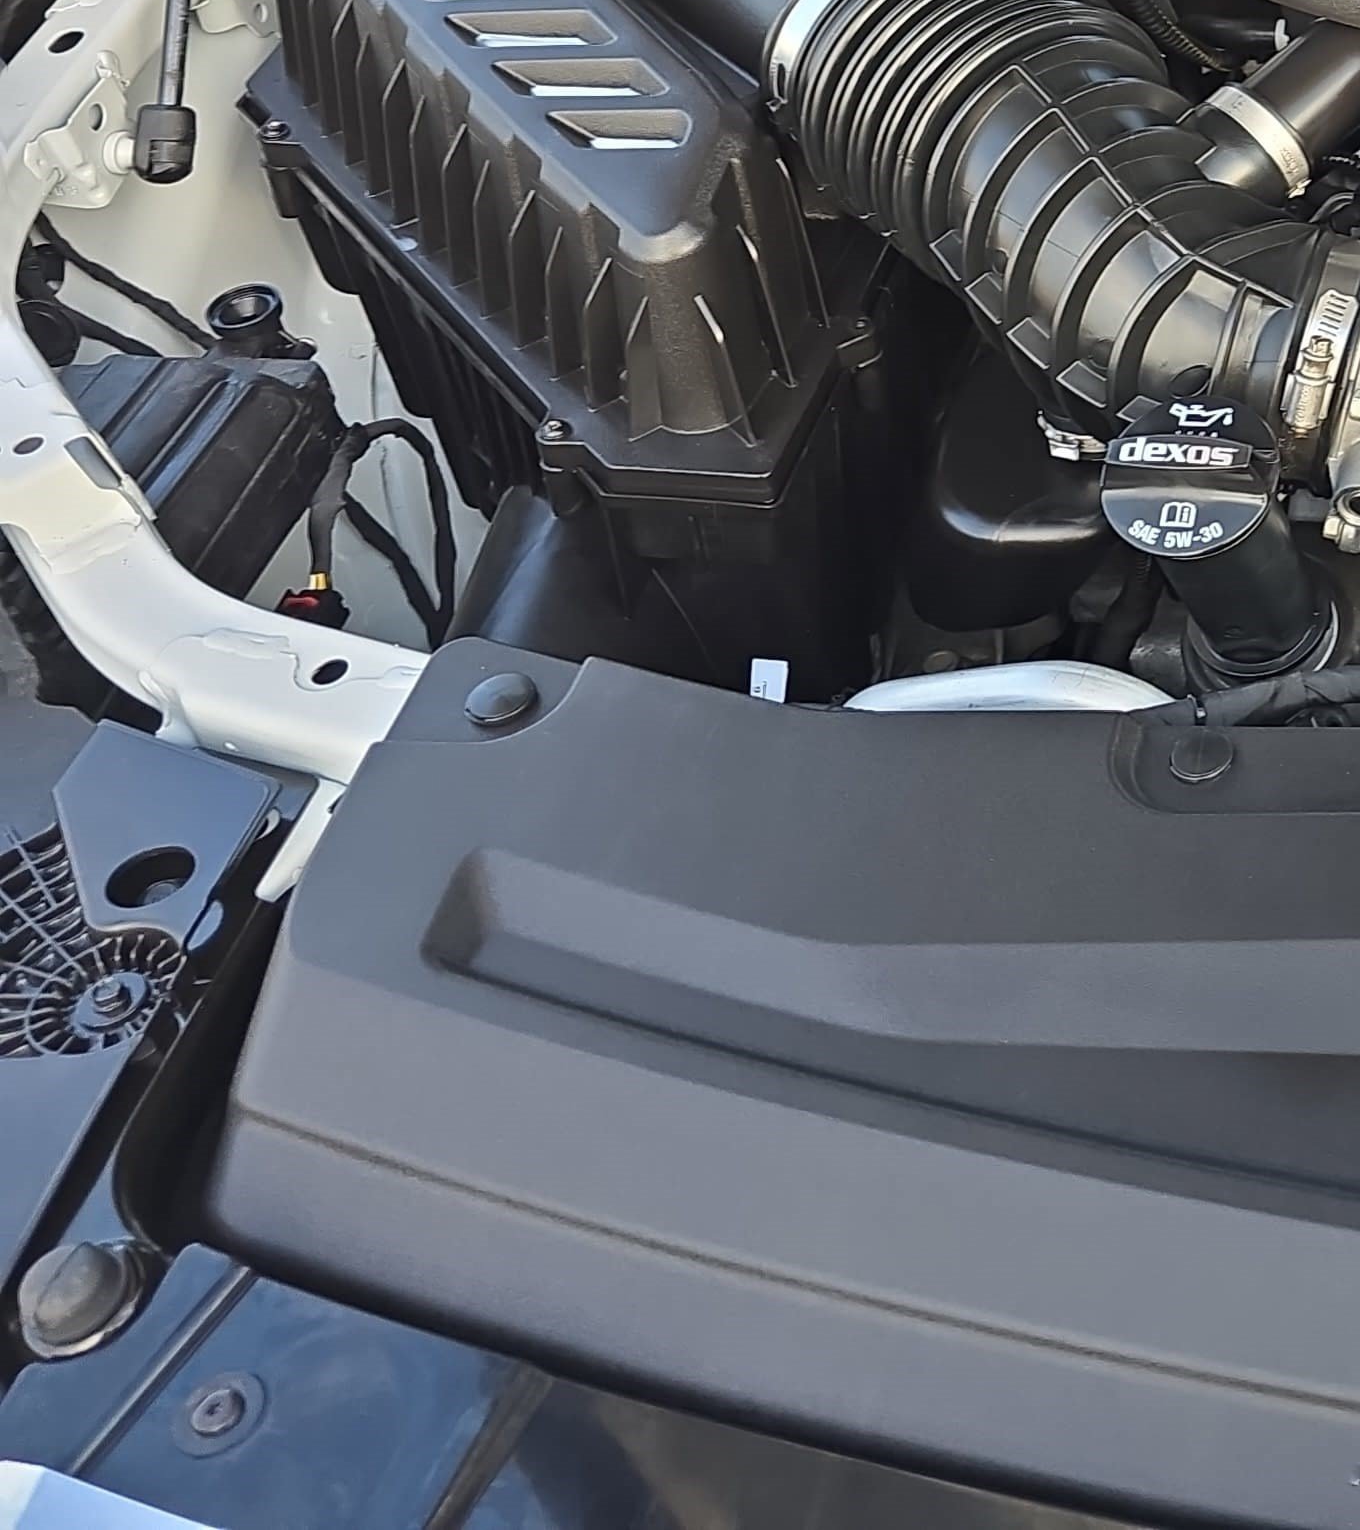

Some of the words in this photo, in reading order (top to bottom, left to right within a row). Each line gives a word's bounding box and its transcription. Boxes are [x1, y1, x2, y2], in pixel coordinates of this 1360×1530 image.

[1119, 437, 1239, 466] dexos
[1128, 519, 1161, 545] SAE
[1164, 522, 1224, 549] 5W-30
